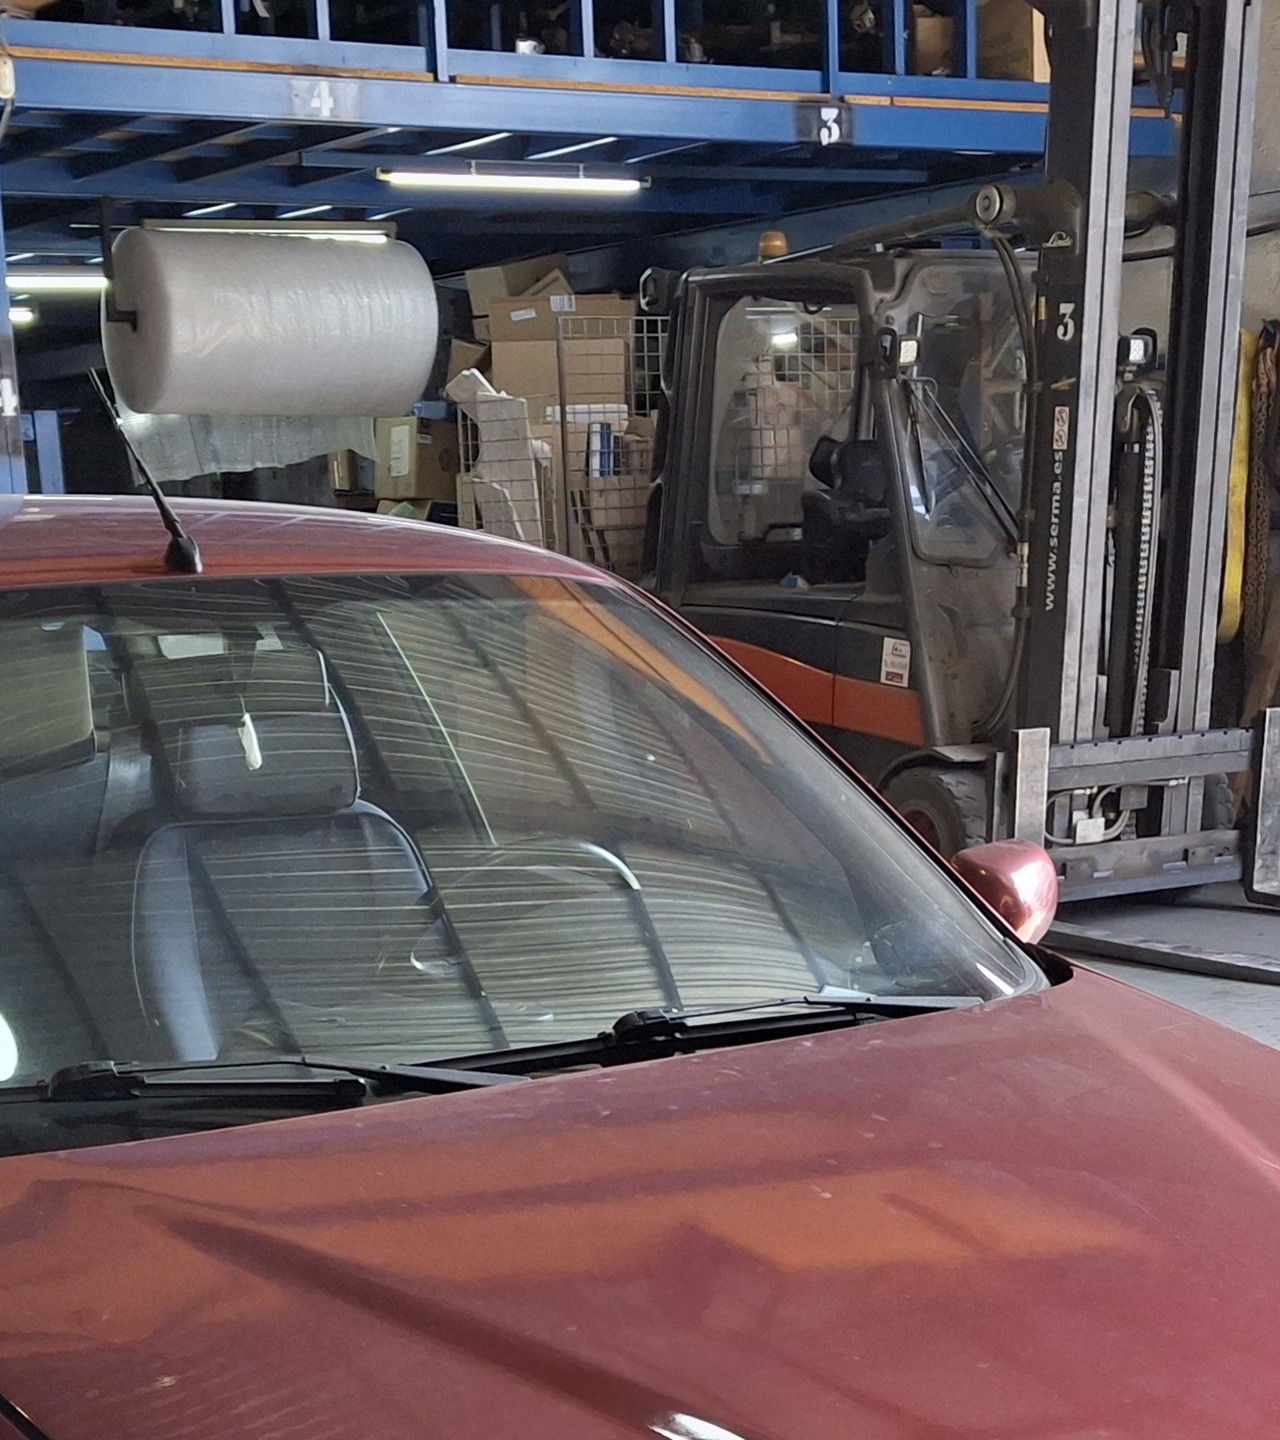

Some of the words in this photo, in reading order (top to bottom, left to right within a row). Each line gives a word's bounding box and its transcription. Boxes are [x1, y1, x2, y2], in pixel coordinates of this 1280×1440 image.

[310, 80, 334, 117] 4
[820, 107, 840, 146] 3
[1056, 303, 1075, 341] 3
[1044, 451, 1064, 612] www.serma.es
